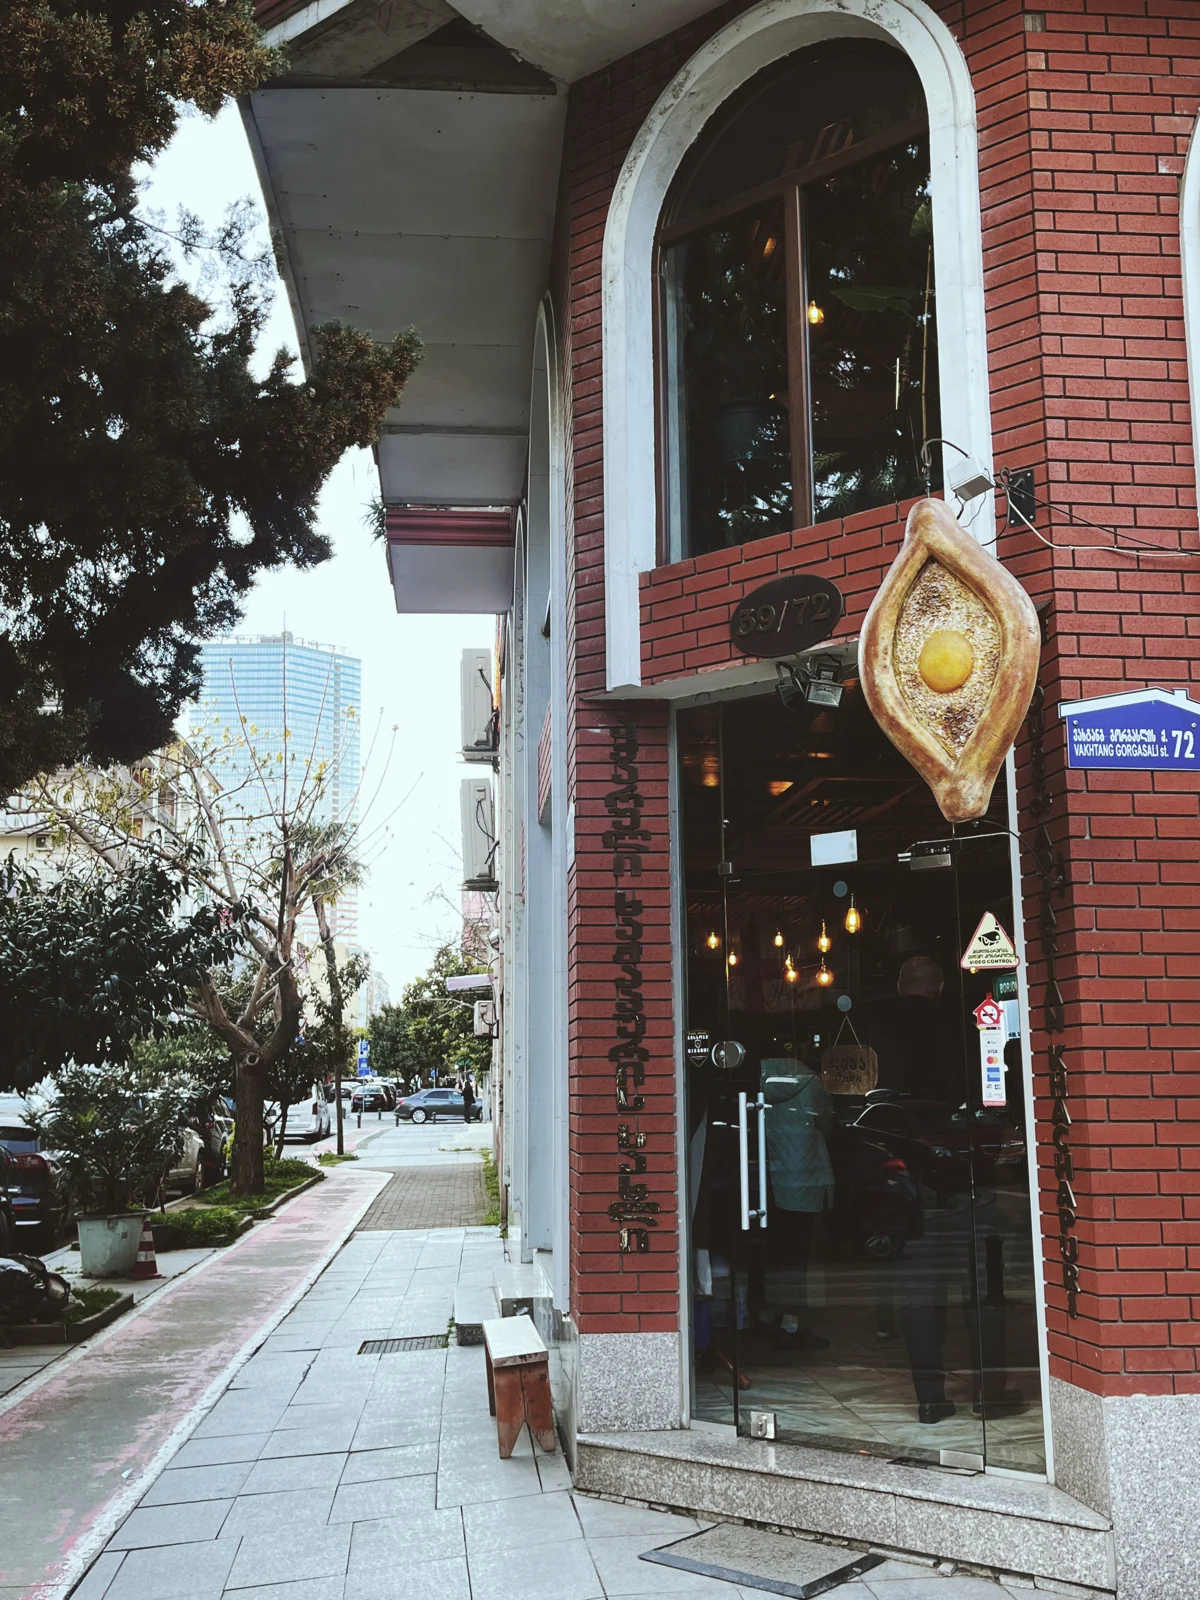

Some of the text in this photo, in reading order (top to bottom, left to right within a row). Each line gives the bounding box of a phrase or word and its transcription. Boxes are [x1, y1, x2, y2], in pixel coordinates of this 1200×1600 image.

[737, 592, 831, 636] 39/72
[1074, 744, 1113, 756] VAKHTANG
[1116, 744, 1158, 757] GORGASALI
[1171, 730, 1196, 758] 72
[1048, 1044, 1081, 1319] KHACHAPURI
